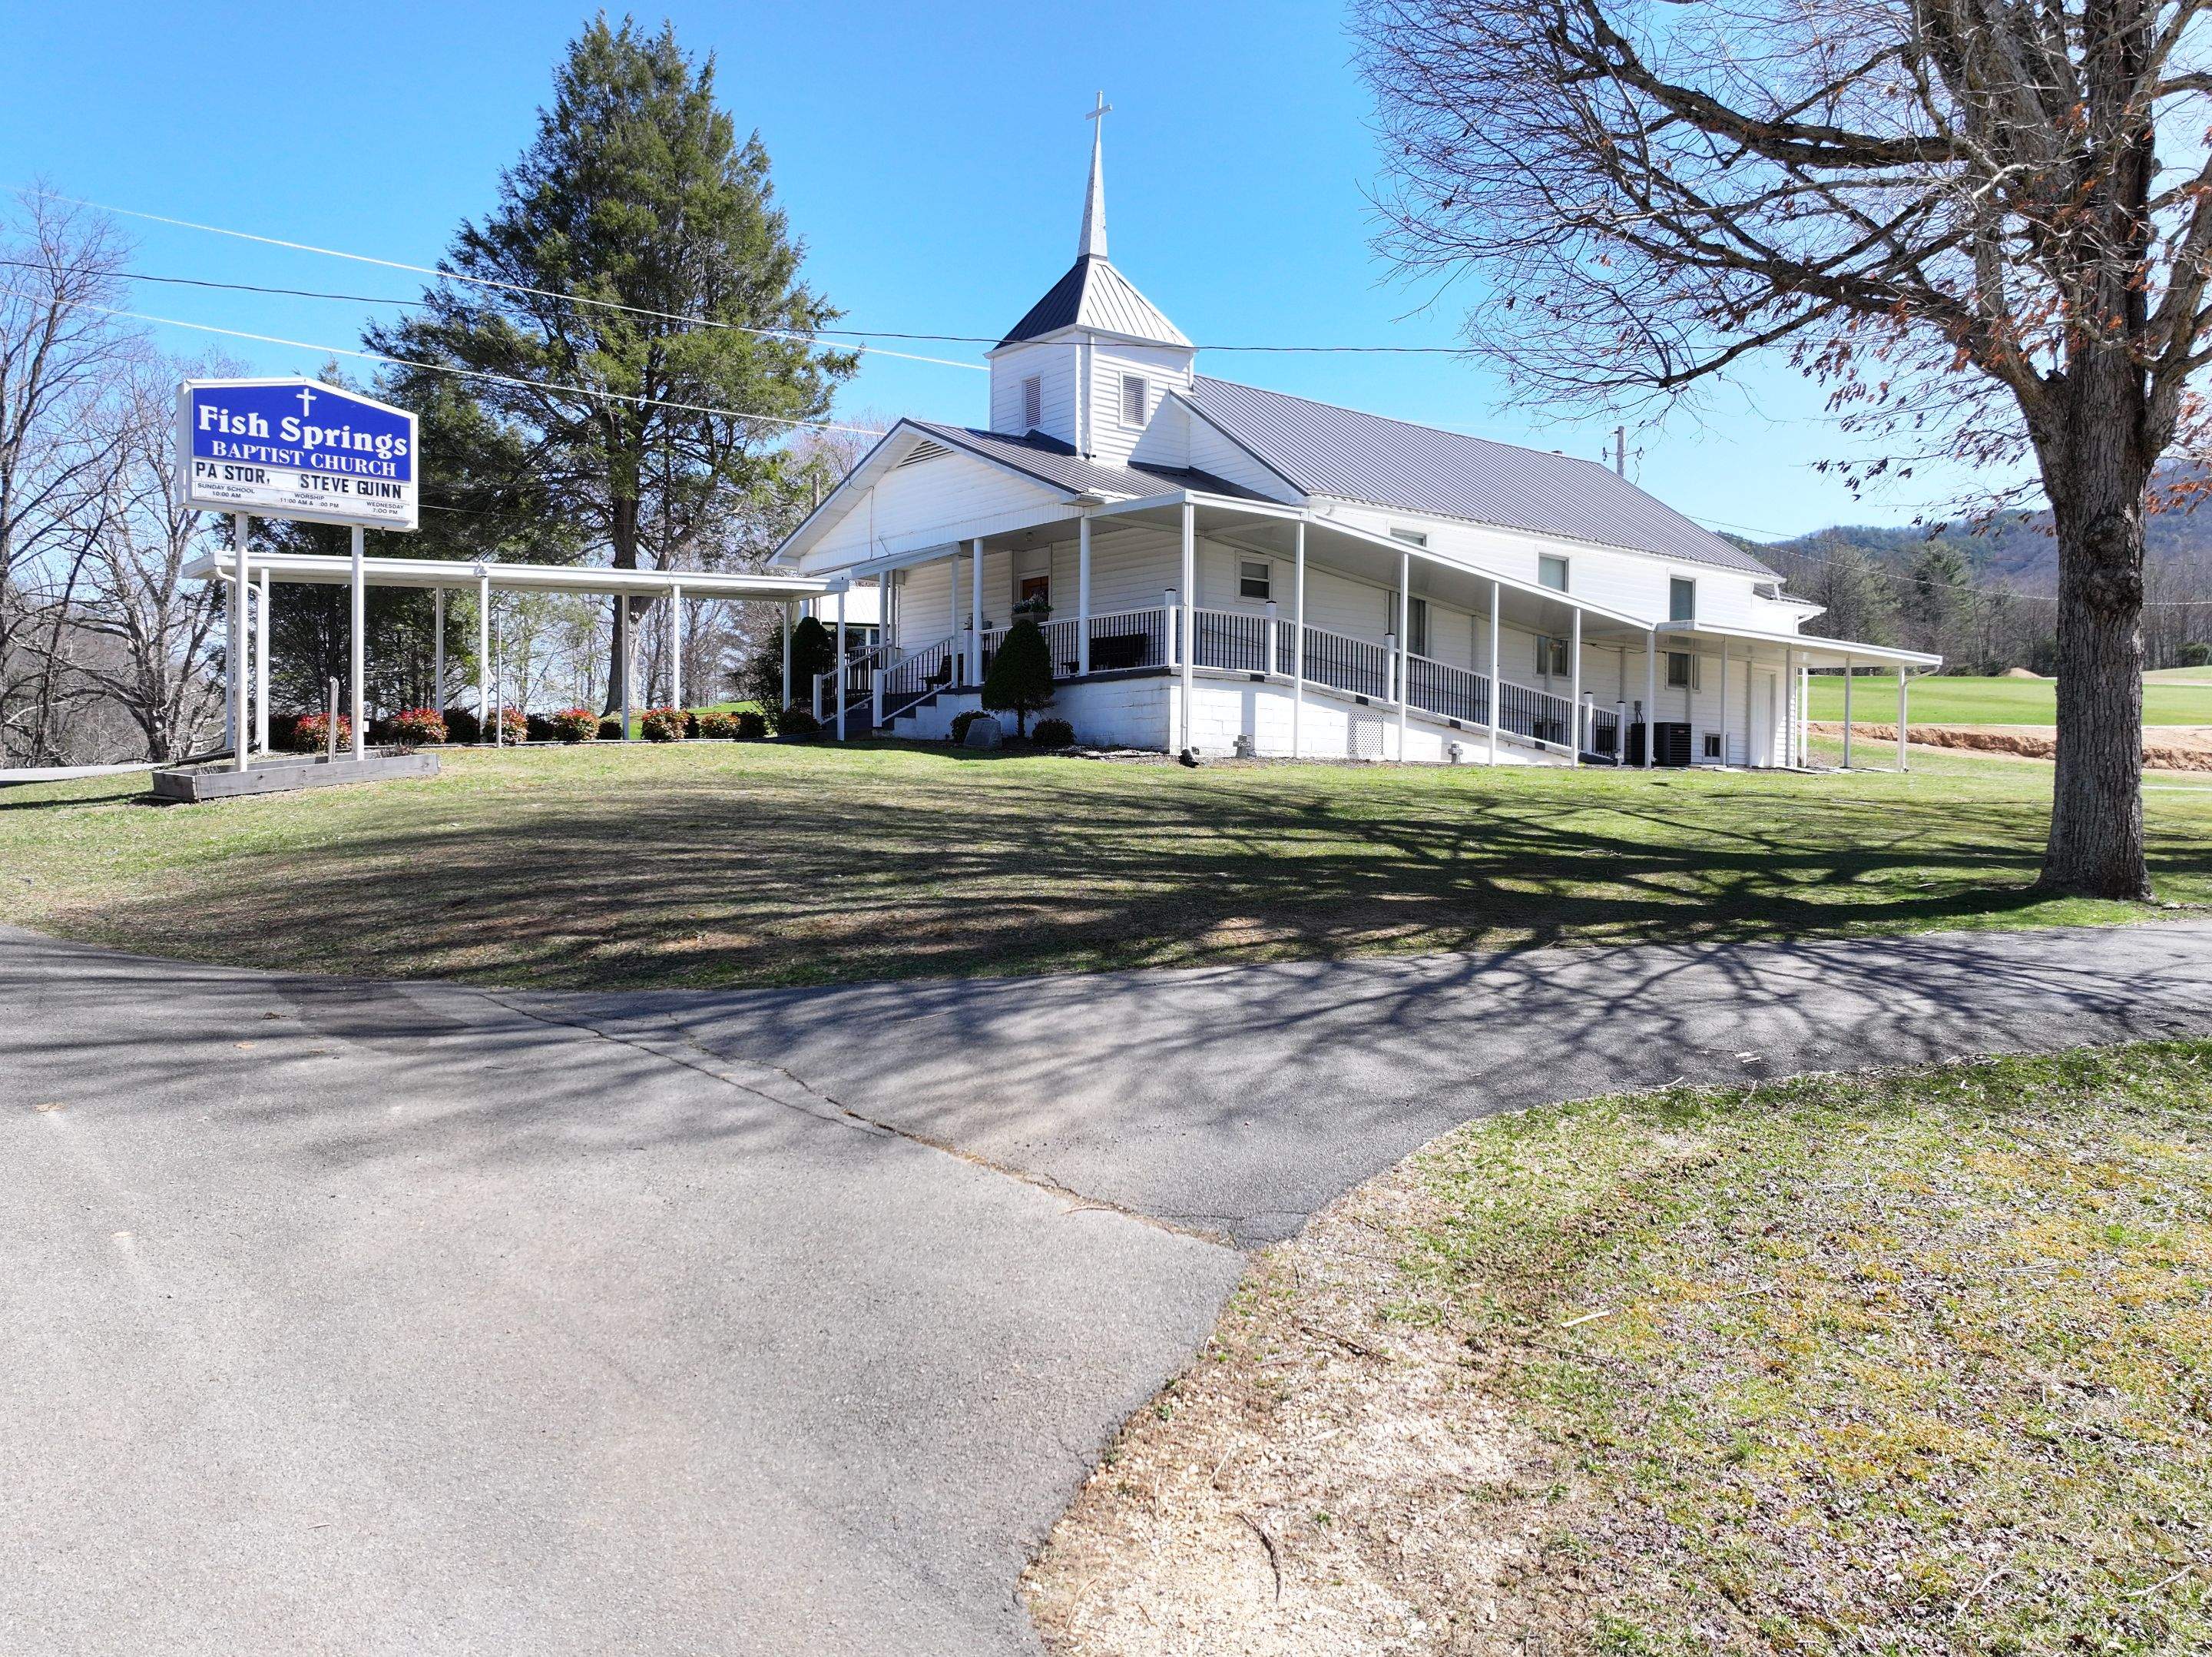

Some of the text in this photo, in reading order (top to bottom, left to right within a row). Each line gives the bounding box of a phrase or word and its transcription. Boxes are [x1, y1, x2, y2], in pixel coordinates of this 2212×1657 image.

[199, 405, 408, 459] Fish Springs
[212, 440, 396, 477] BAPTIST CHURCH
[227, 486, 255, 494] SCHOOL
[300, 474, 349, 493] STEVE
[357, 479, 402, 499] GUINN
[294, 492, 325, 501] WORSHIP
[366, 501, 404, 509] WEDNESDAY
